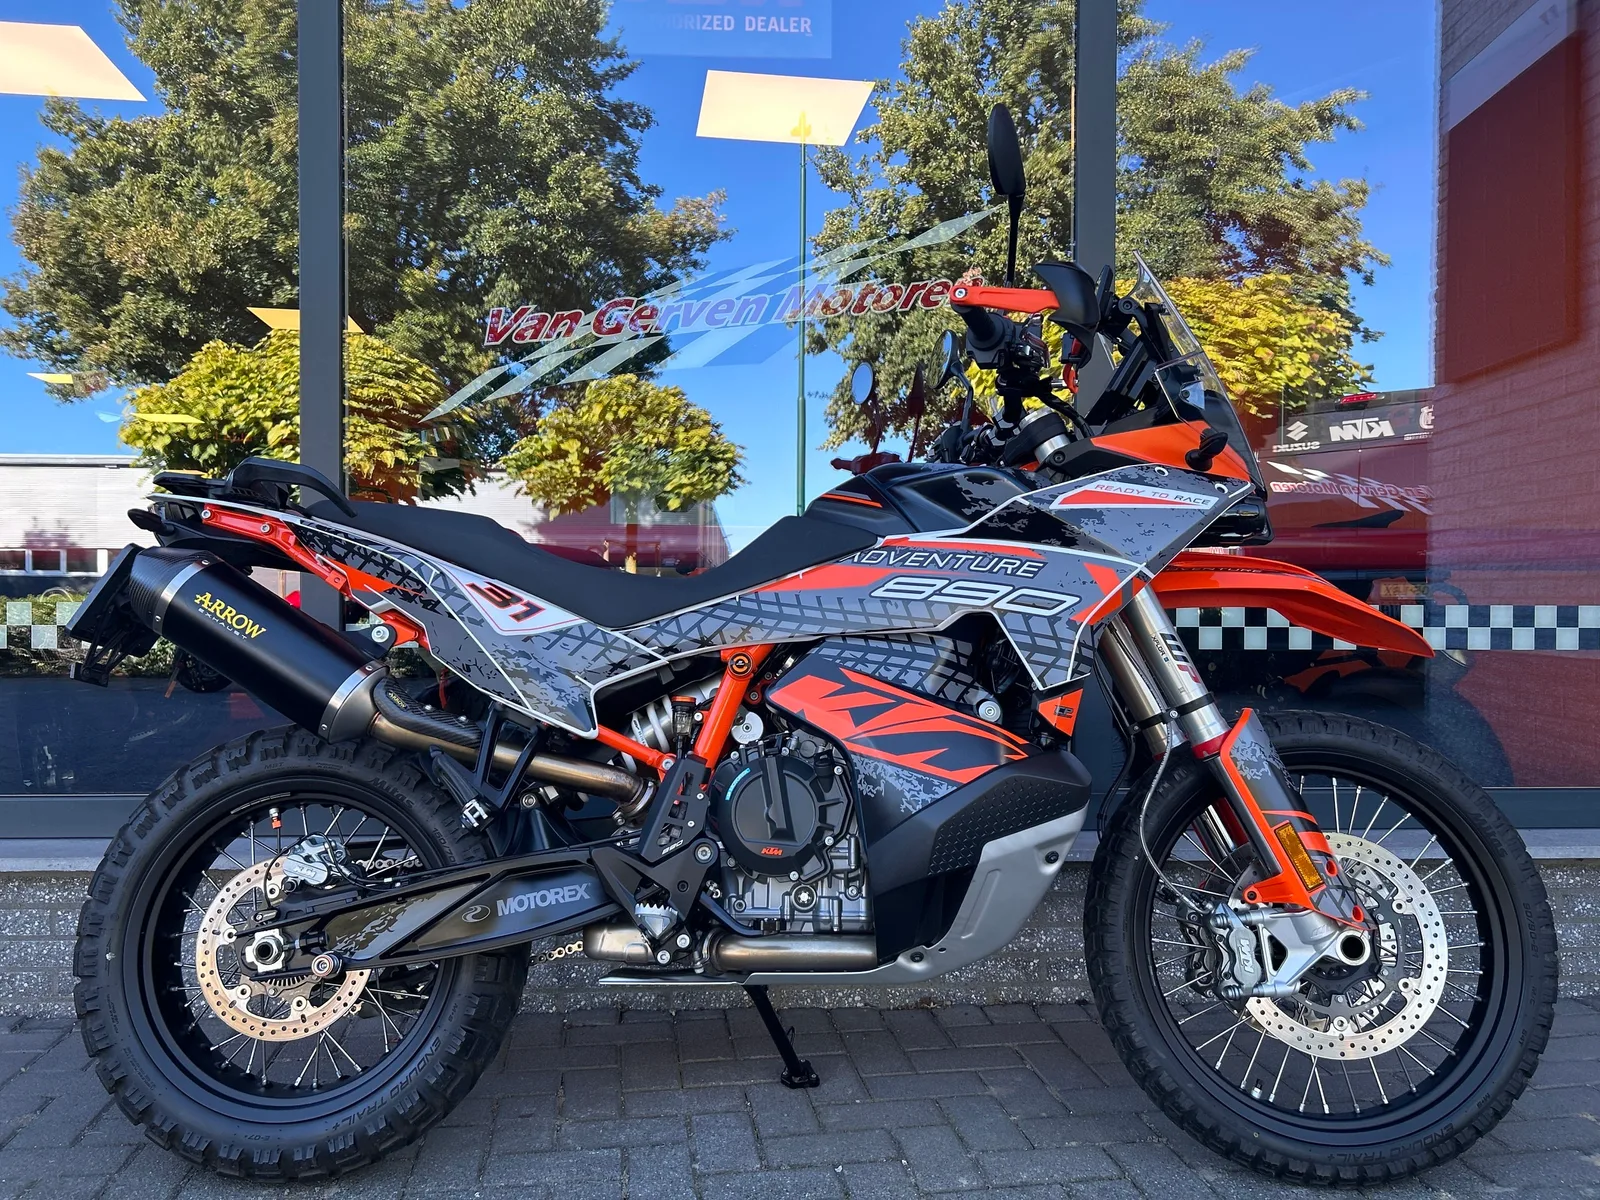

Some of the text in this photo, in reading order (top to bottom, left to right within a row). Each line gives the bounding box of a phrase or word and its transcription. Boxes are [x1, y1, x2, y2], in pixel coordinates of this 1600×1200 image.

[745, 15, 812, 33] DEALER
[484, 304, 585, 346] Van
[591, 293, 770, 337] Gerven
[1095, 484, 1211, 505] READY TO RACE
[870, 575, 1083, 617] 890
[194, 591, 267, 639] ARROW
[197, 607, 248, 640] EXHAUST
[760, 846, 783, 856] KTM
[496, 882, 591, 917] MOTOREX
[1238, 938, 1255, 974] KTM
[389, 1036, 442, 1099] ENDURO
